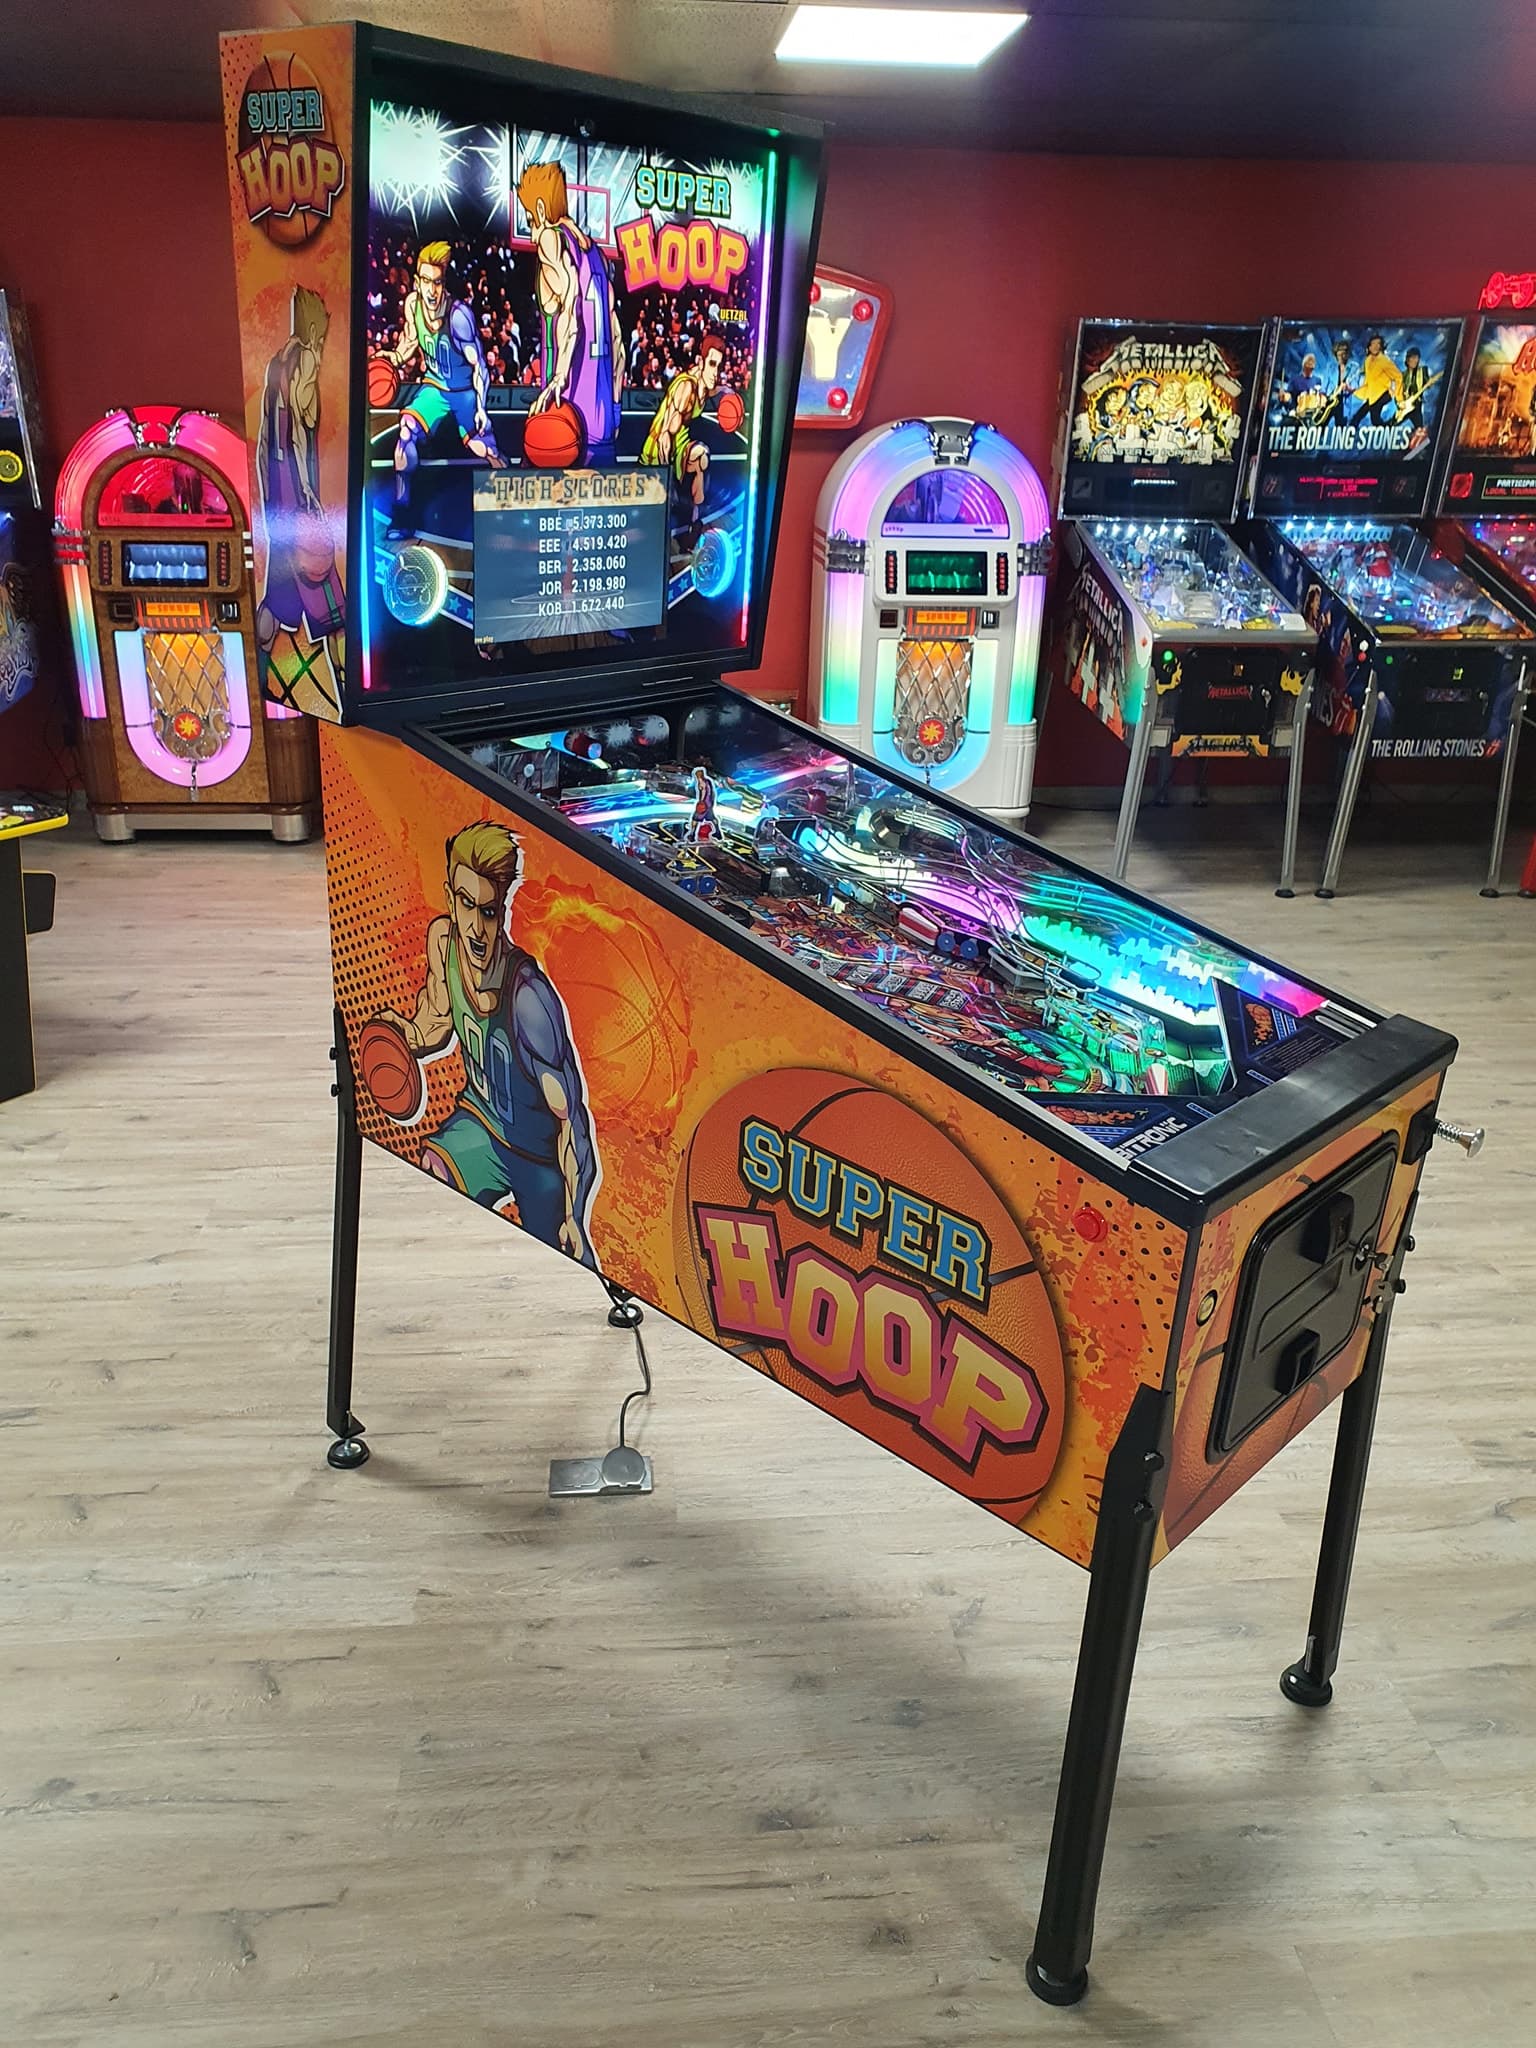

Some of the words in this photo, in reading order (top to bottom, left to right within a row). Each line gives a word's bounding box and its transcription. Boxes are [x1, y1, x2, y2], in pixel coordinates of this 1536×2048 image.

[246, 89, 322, 129] SUPER
[236, 140, 344, 218] HOOP
[636, 165, 731, 217] SUPER
[615, 217, 749, 294] HOOP
[1084, 336, 1240, 388] METALLICA
[1269, 426, 1294, 450] THE
[1296, 426, 1355, 450] ROLLING
[1357, 426, 1412, 450] STONES
[496, 477, 553, 501] HIGH
[564, 475, 646, 499] SCORES
[539, 517, 562, 531] BBE
[573, 514, 627, 530] 5.373.300
[539, 538, 561, 553] EEE
[572, 535, 627, 551] 4.519.420
[539, 560, 562, 574] BER
[572, 555, 626, 572] 2.358.060
[539, 581, 562, 596] JOR
[572, 576, 626, 593] 2.198.980
[538, 602, 562, 617] KOB
[572, 596, 625, 613] 1.672.440
[1371, 739, 1392, 757] THE
[1394, 739, 1441, 757] ROLLING
[1442, 739, 1487, 757] STONES
[741, 1118, 988, 1303] SUPER
[696, 1206, 1046, 1465] HOOP
